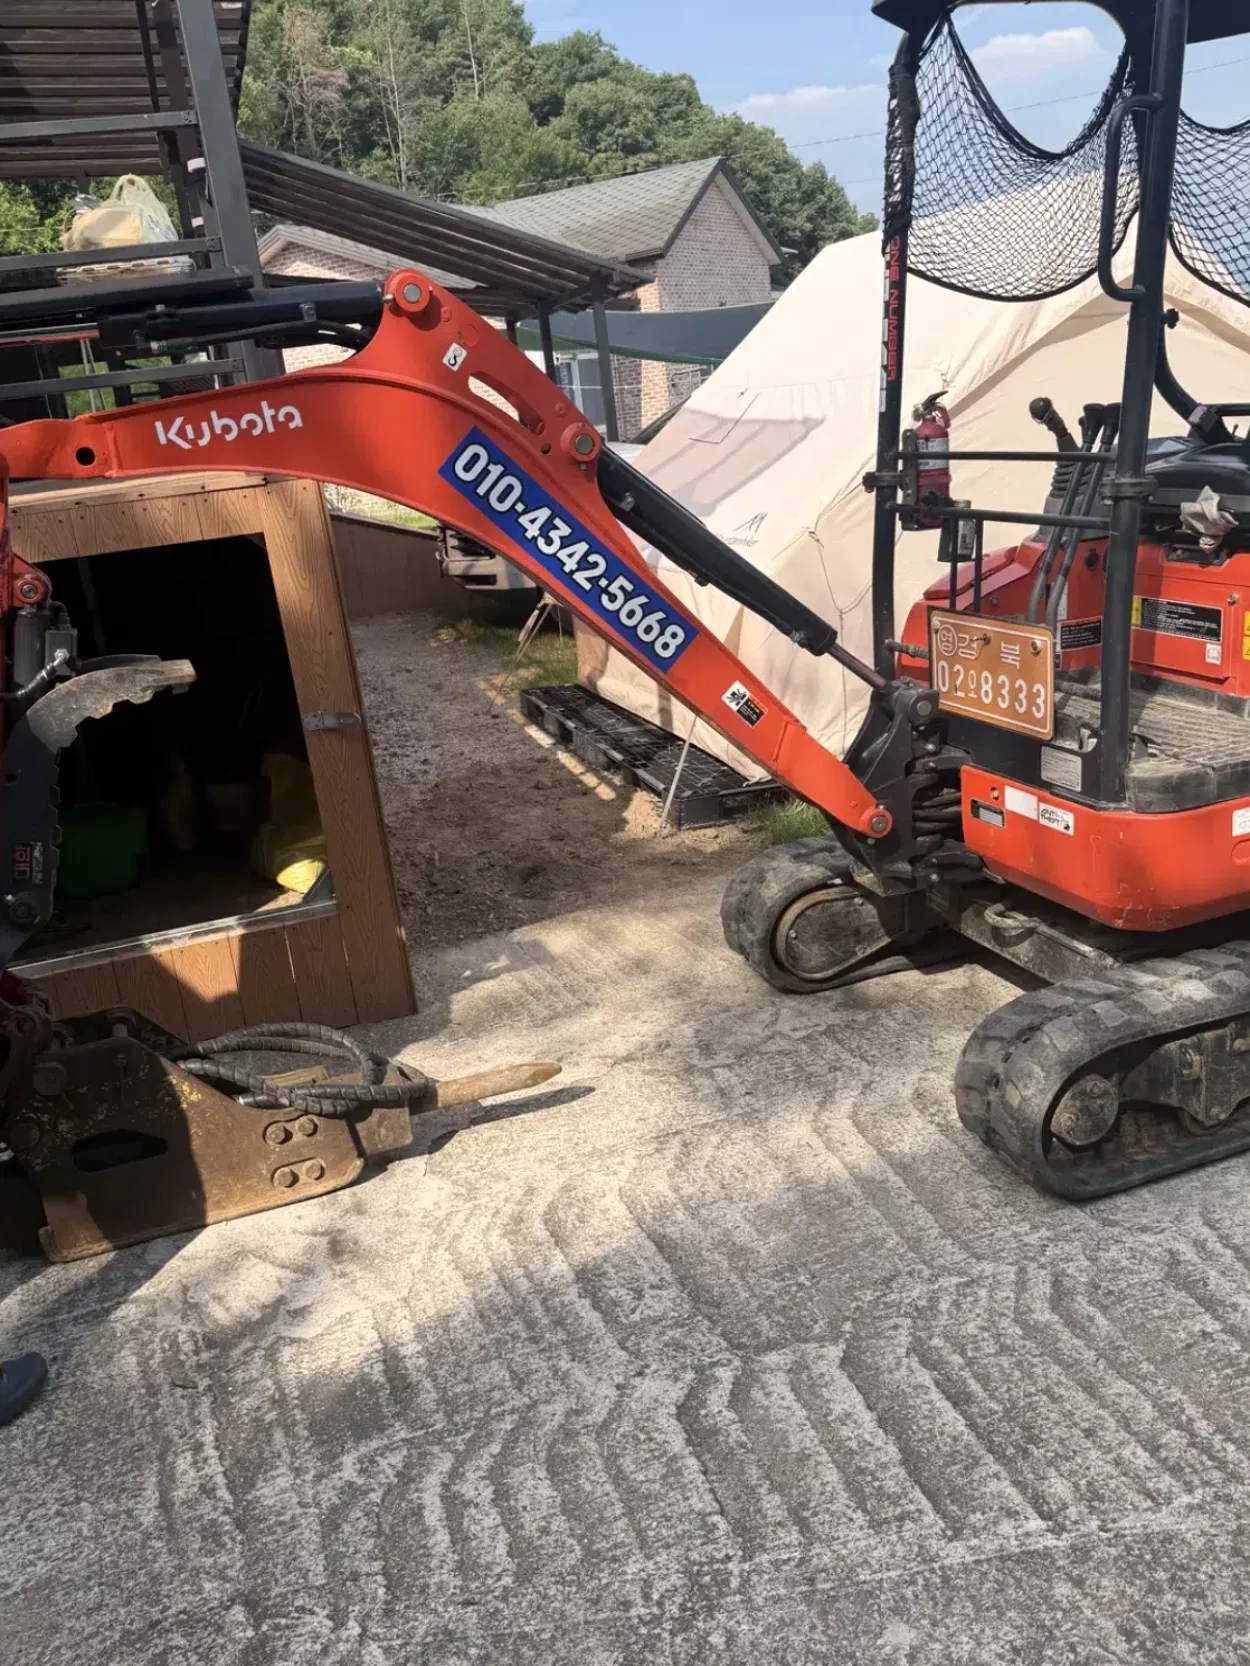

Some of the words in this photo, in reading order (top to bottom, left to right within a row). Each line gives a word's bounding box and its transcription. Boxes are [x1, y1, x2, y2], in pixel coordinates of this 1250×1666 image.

[889, 235, 900, 281] ONE
[887, 289, 899, 381] NUMBER
[154, 400, 303, 450] Kubota
[453, 443, 686, 659] 010-4342-5668
[938, 660, 1045, 719] 02오8333
